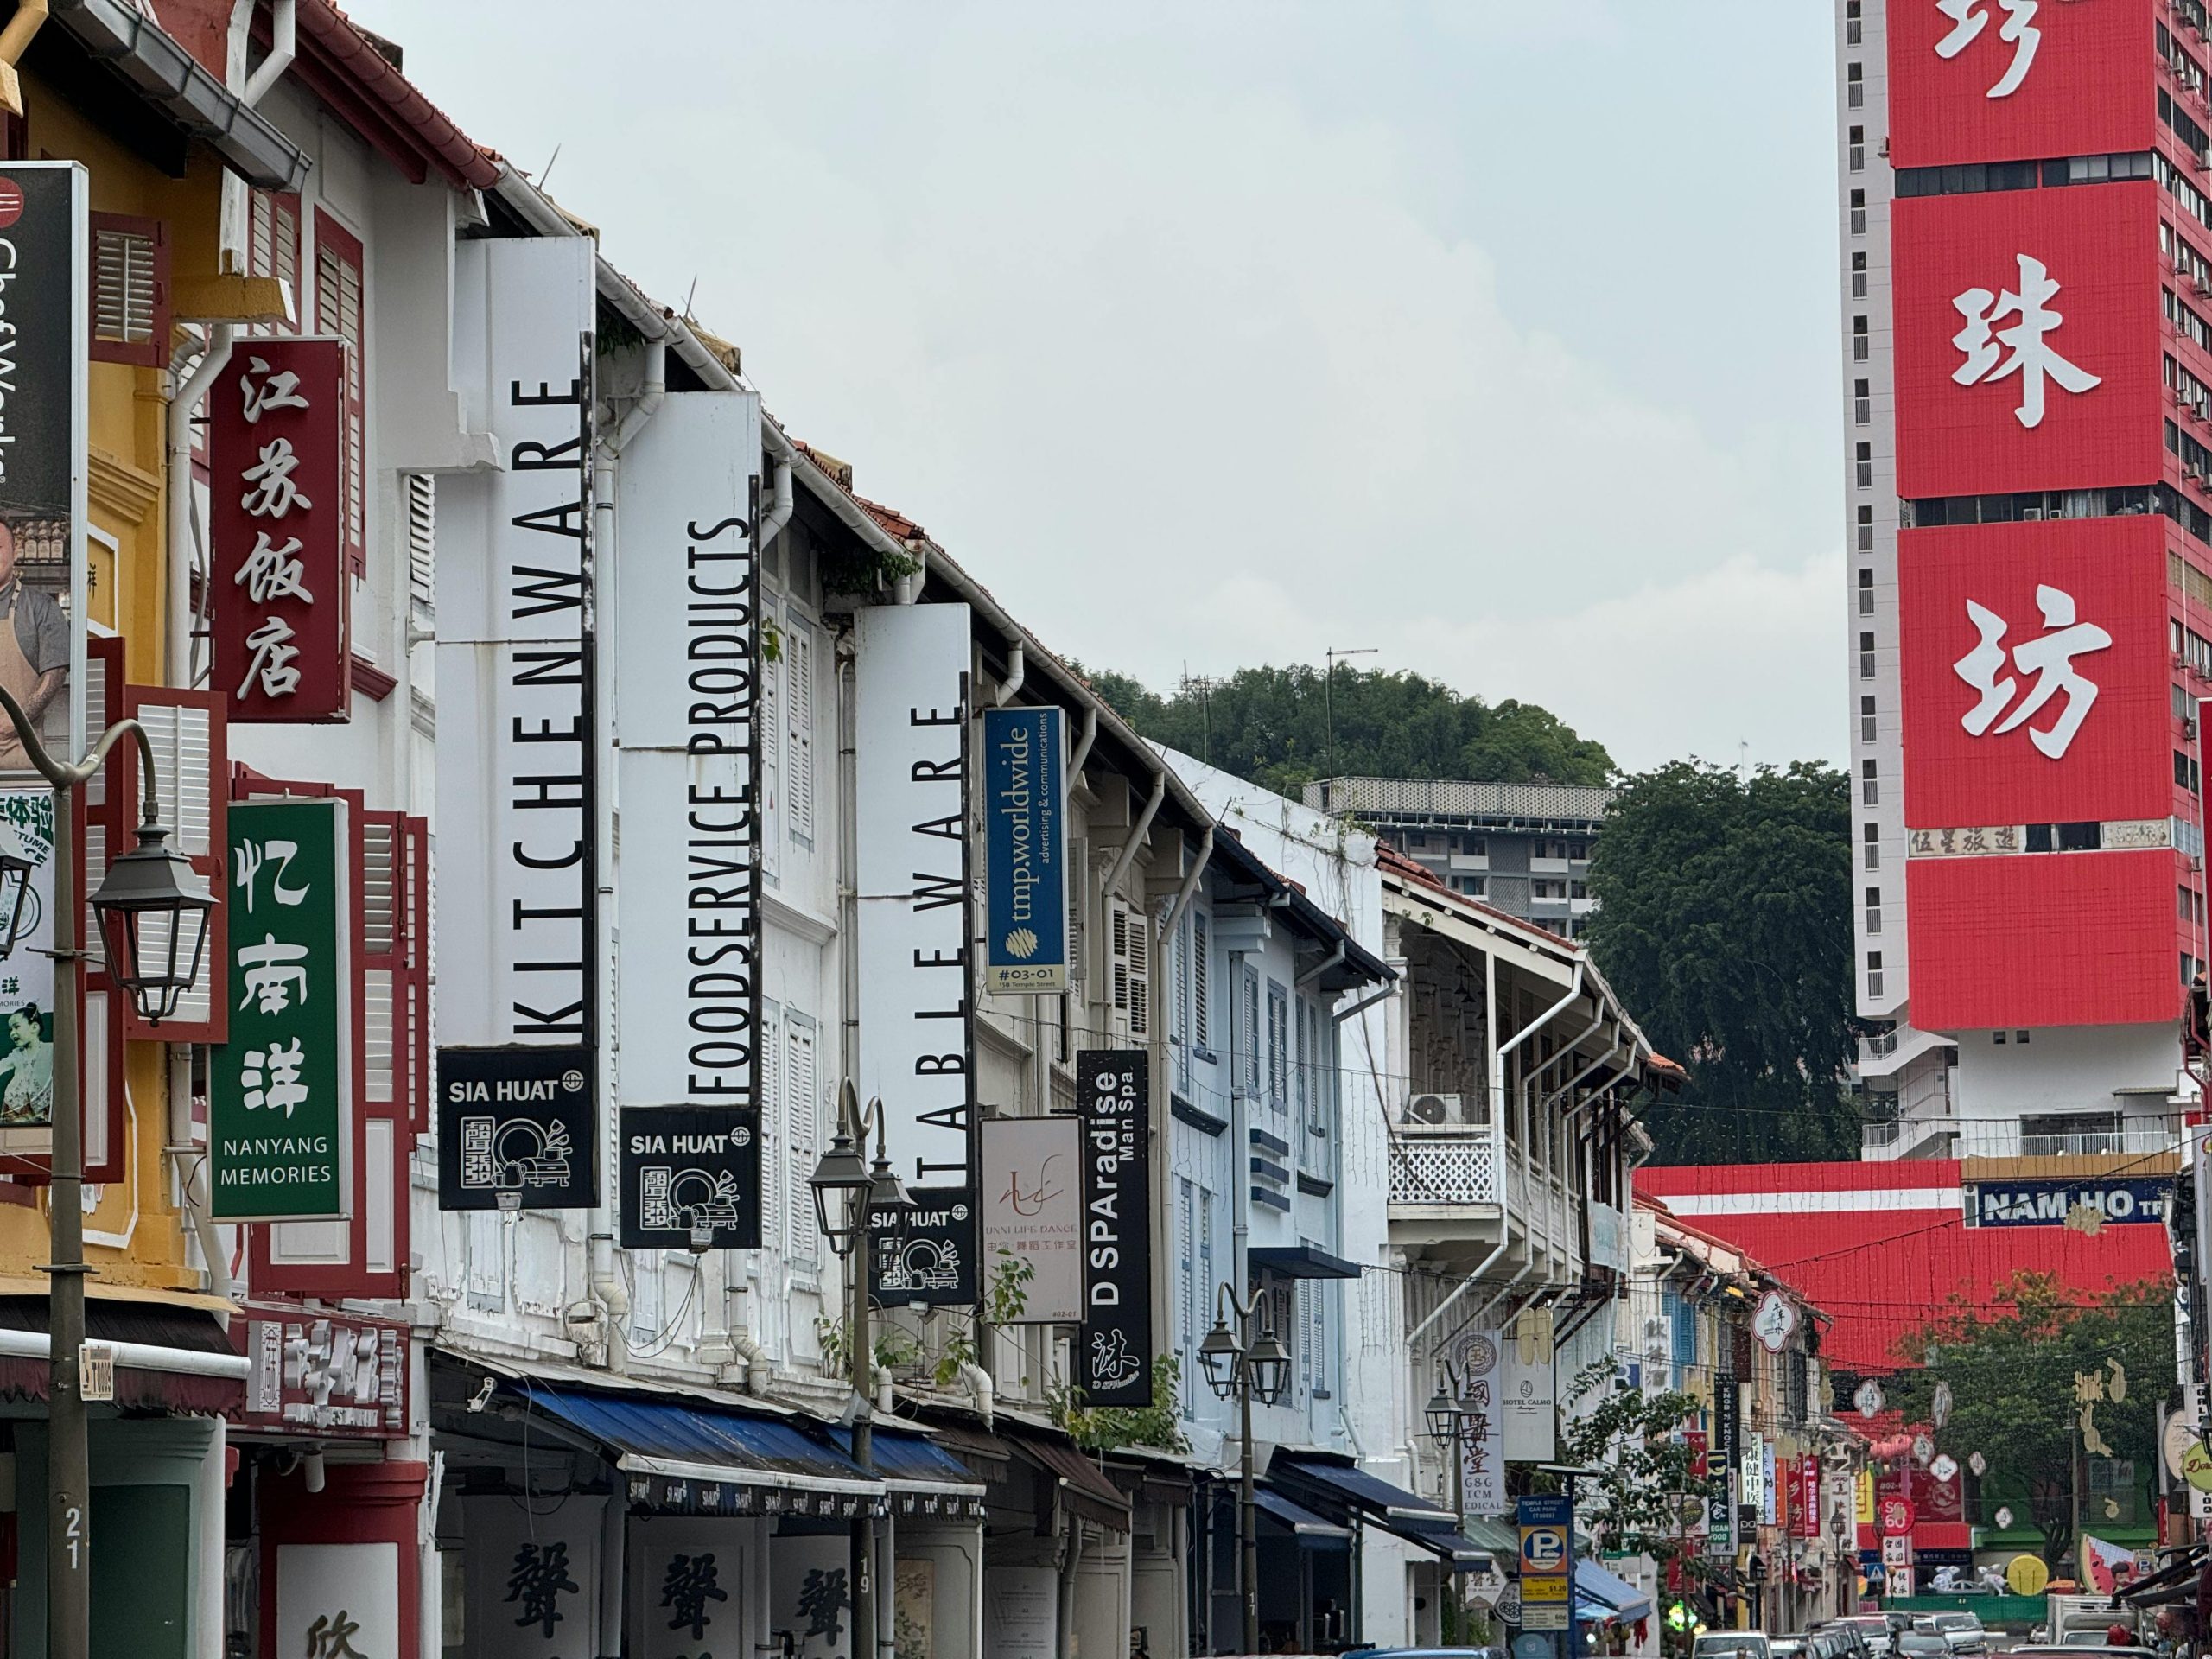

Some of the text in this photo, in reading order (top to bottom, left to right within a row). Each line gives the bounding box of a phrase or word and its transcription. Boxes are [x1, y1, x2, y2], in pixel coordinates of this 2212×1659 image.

[1934, 0, 2113, 760] 珍珠坊
[234, 354, 314, 701] 江苏饭店
[511, 378, 582, 1034] KITCHENWARE
[1038, 712, 1052, 864] advertising & communications
[687, 518, 750, 1095] FOODSERVICE PRODUCTS
[1001, 727, 1039, 923] tmp.worldwide
[14, 830, 50, 855] TUME
[910, 705, 966, 1179] TABLEWARE
[2, 976, 20, 995] 洋
[233, 836, 311, 1119] 忆南洋
[999, 969, 1053, 981] #03-01
[448, 1079, 558, 1103] SIA HUAT
[1117, 1071, 1137, 1161] Man Spa
[224, 1136, 327, 1156] NANYANG
[630, 1135, 728, 1154] SIA HUAT
[220, 1166, 331, 1185] MEMORIES
[1090, 1071, 1119, 1306] D SPAradise
[1984, 1192, 2067, 1221] NAM
[2080, 1190, 2134, 1217] HO
[870, 1211, 949, 1228] SIA HUAT
[985, 1224, 1077, 1235] UNNI LIFE DANCE
[1465, 1478, 1493, 1487] G&G
[1466, 1491, 1491, 1499] TCM
[1533, 1533, 1560, 1558] P
